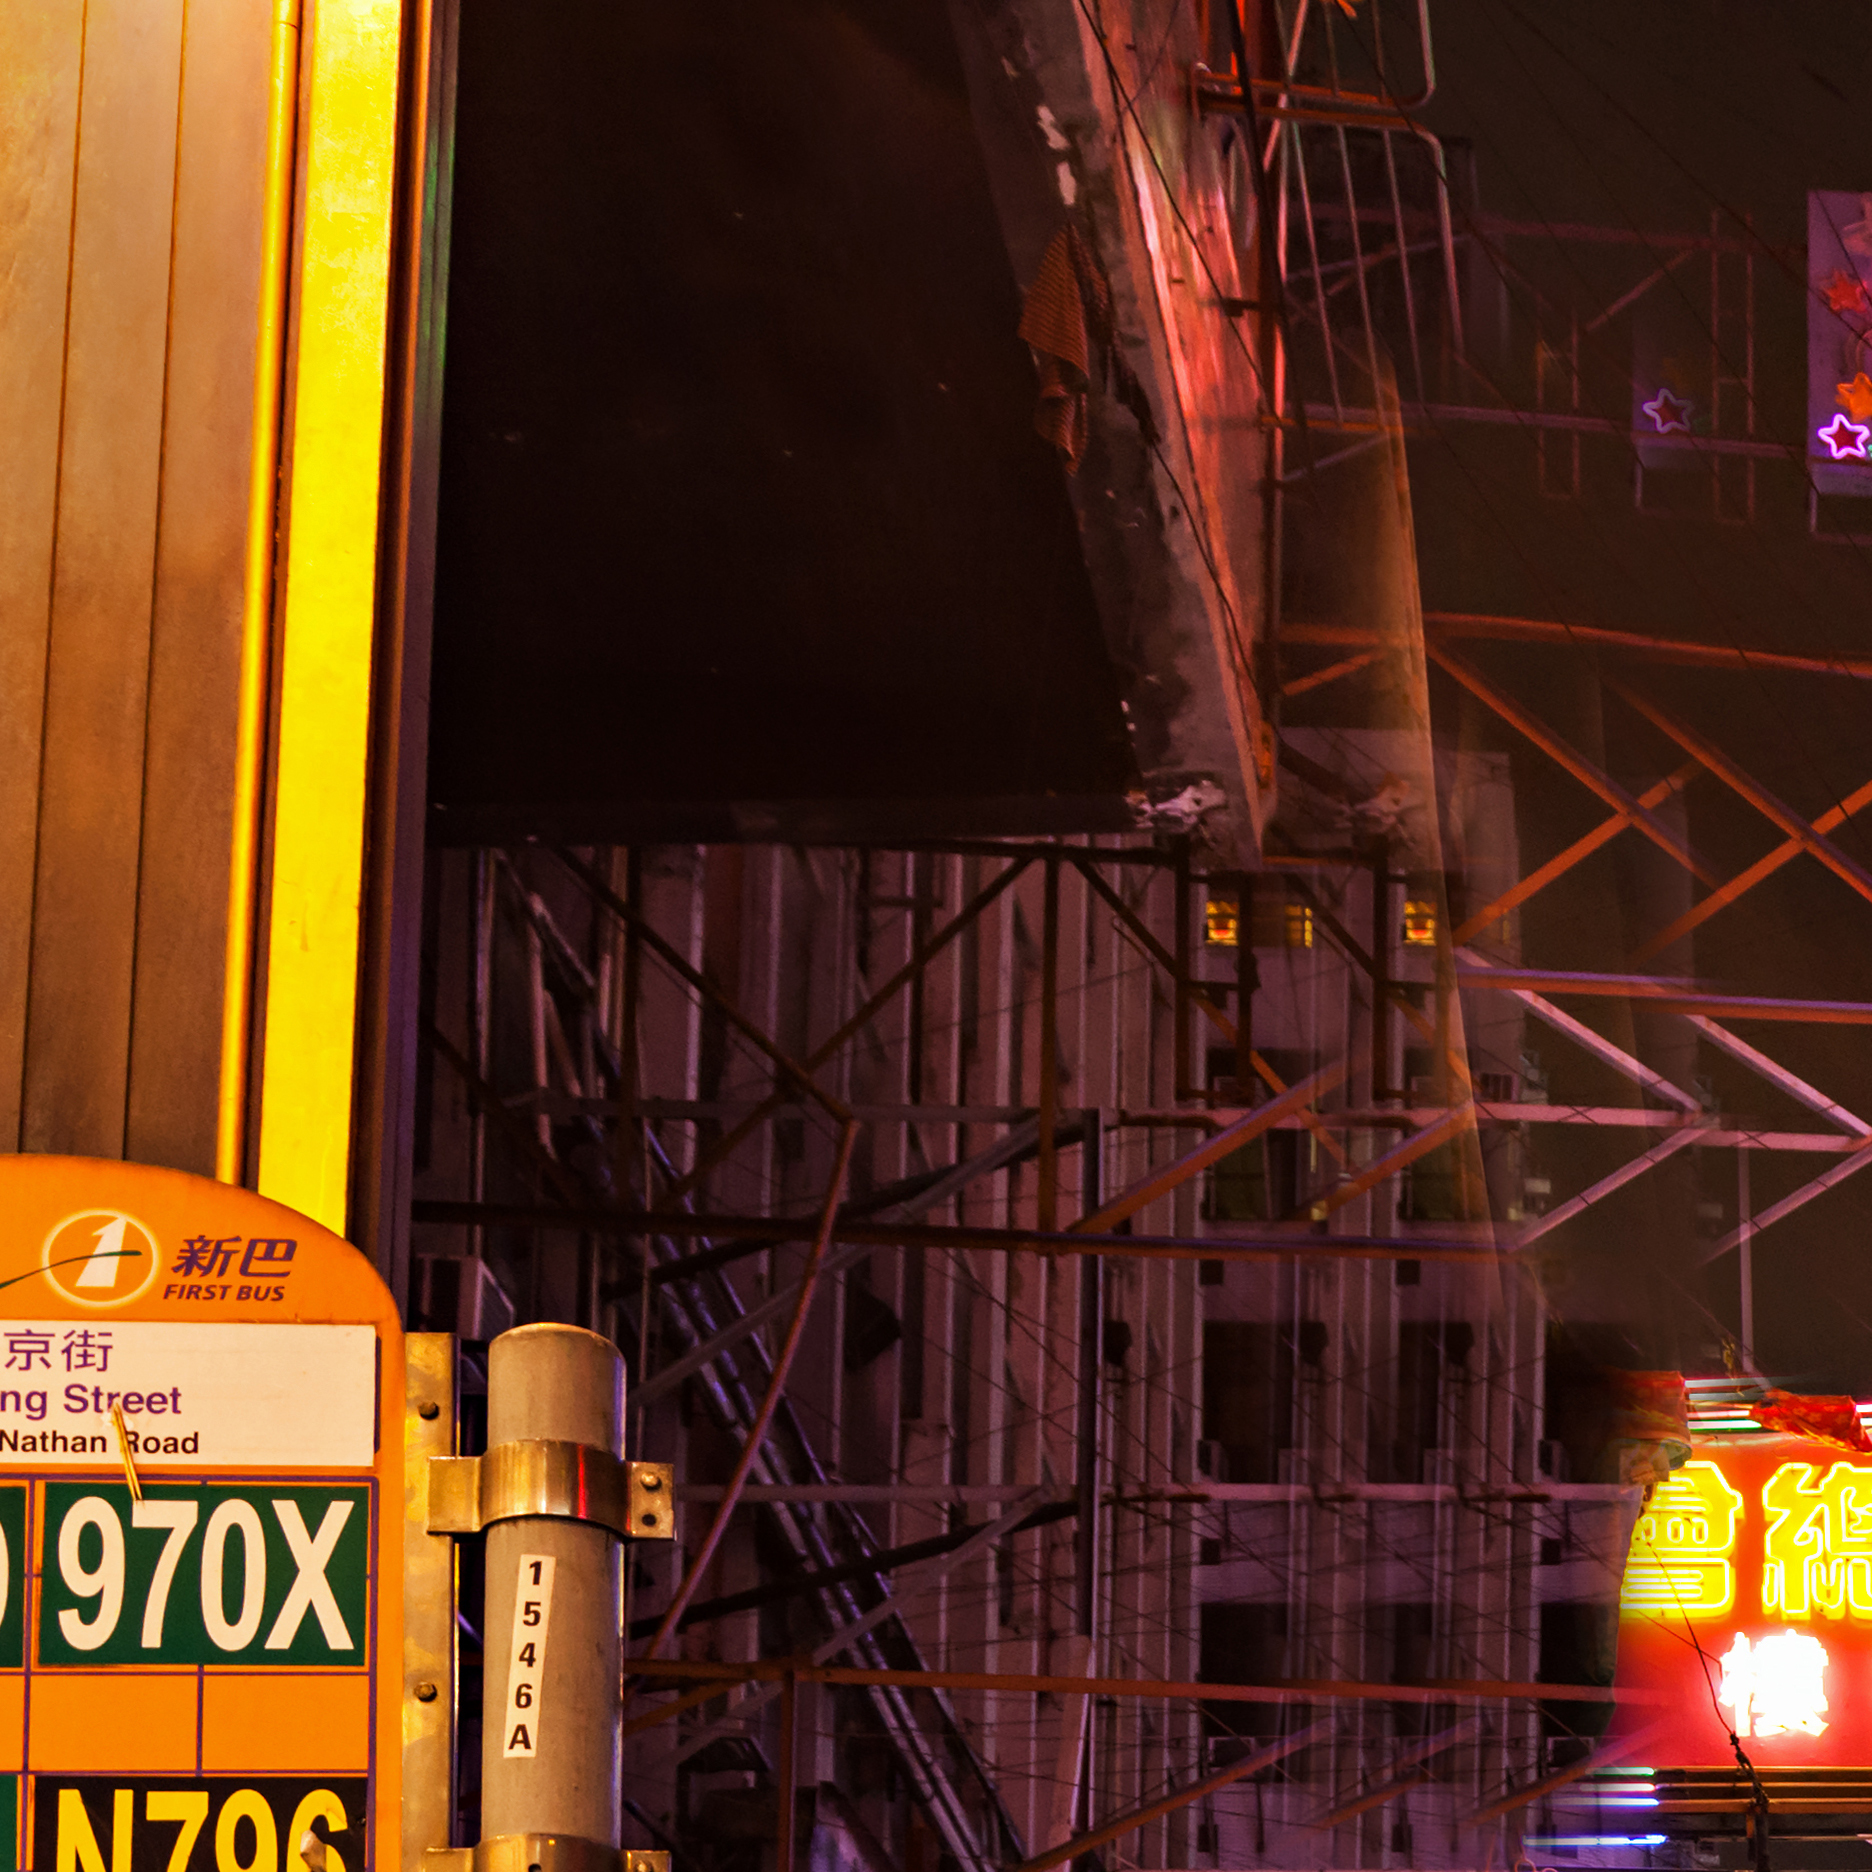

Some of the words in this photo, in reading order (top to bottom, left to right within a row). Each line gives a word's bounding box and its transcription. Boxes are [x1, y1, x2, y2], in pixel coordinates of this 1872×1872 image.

[171, 1234, 297, 1278] 新巴
[163, 1283, 229, 1302] FIRST
[236, 1284, 285, 1302] BUS
[3, 1328, 114, 1373] 京街
[63, 1383, 182, 1415] Street
[0, 1430, 107, 1454] Nathan
[125, 1430, 200, 1454] Road
[58, 1494, 355, 1652] 970X
[507, 1560, 544, 1751] 1546A
